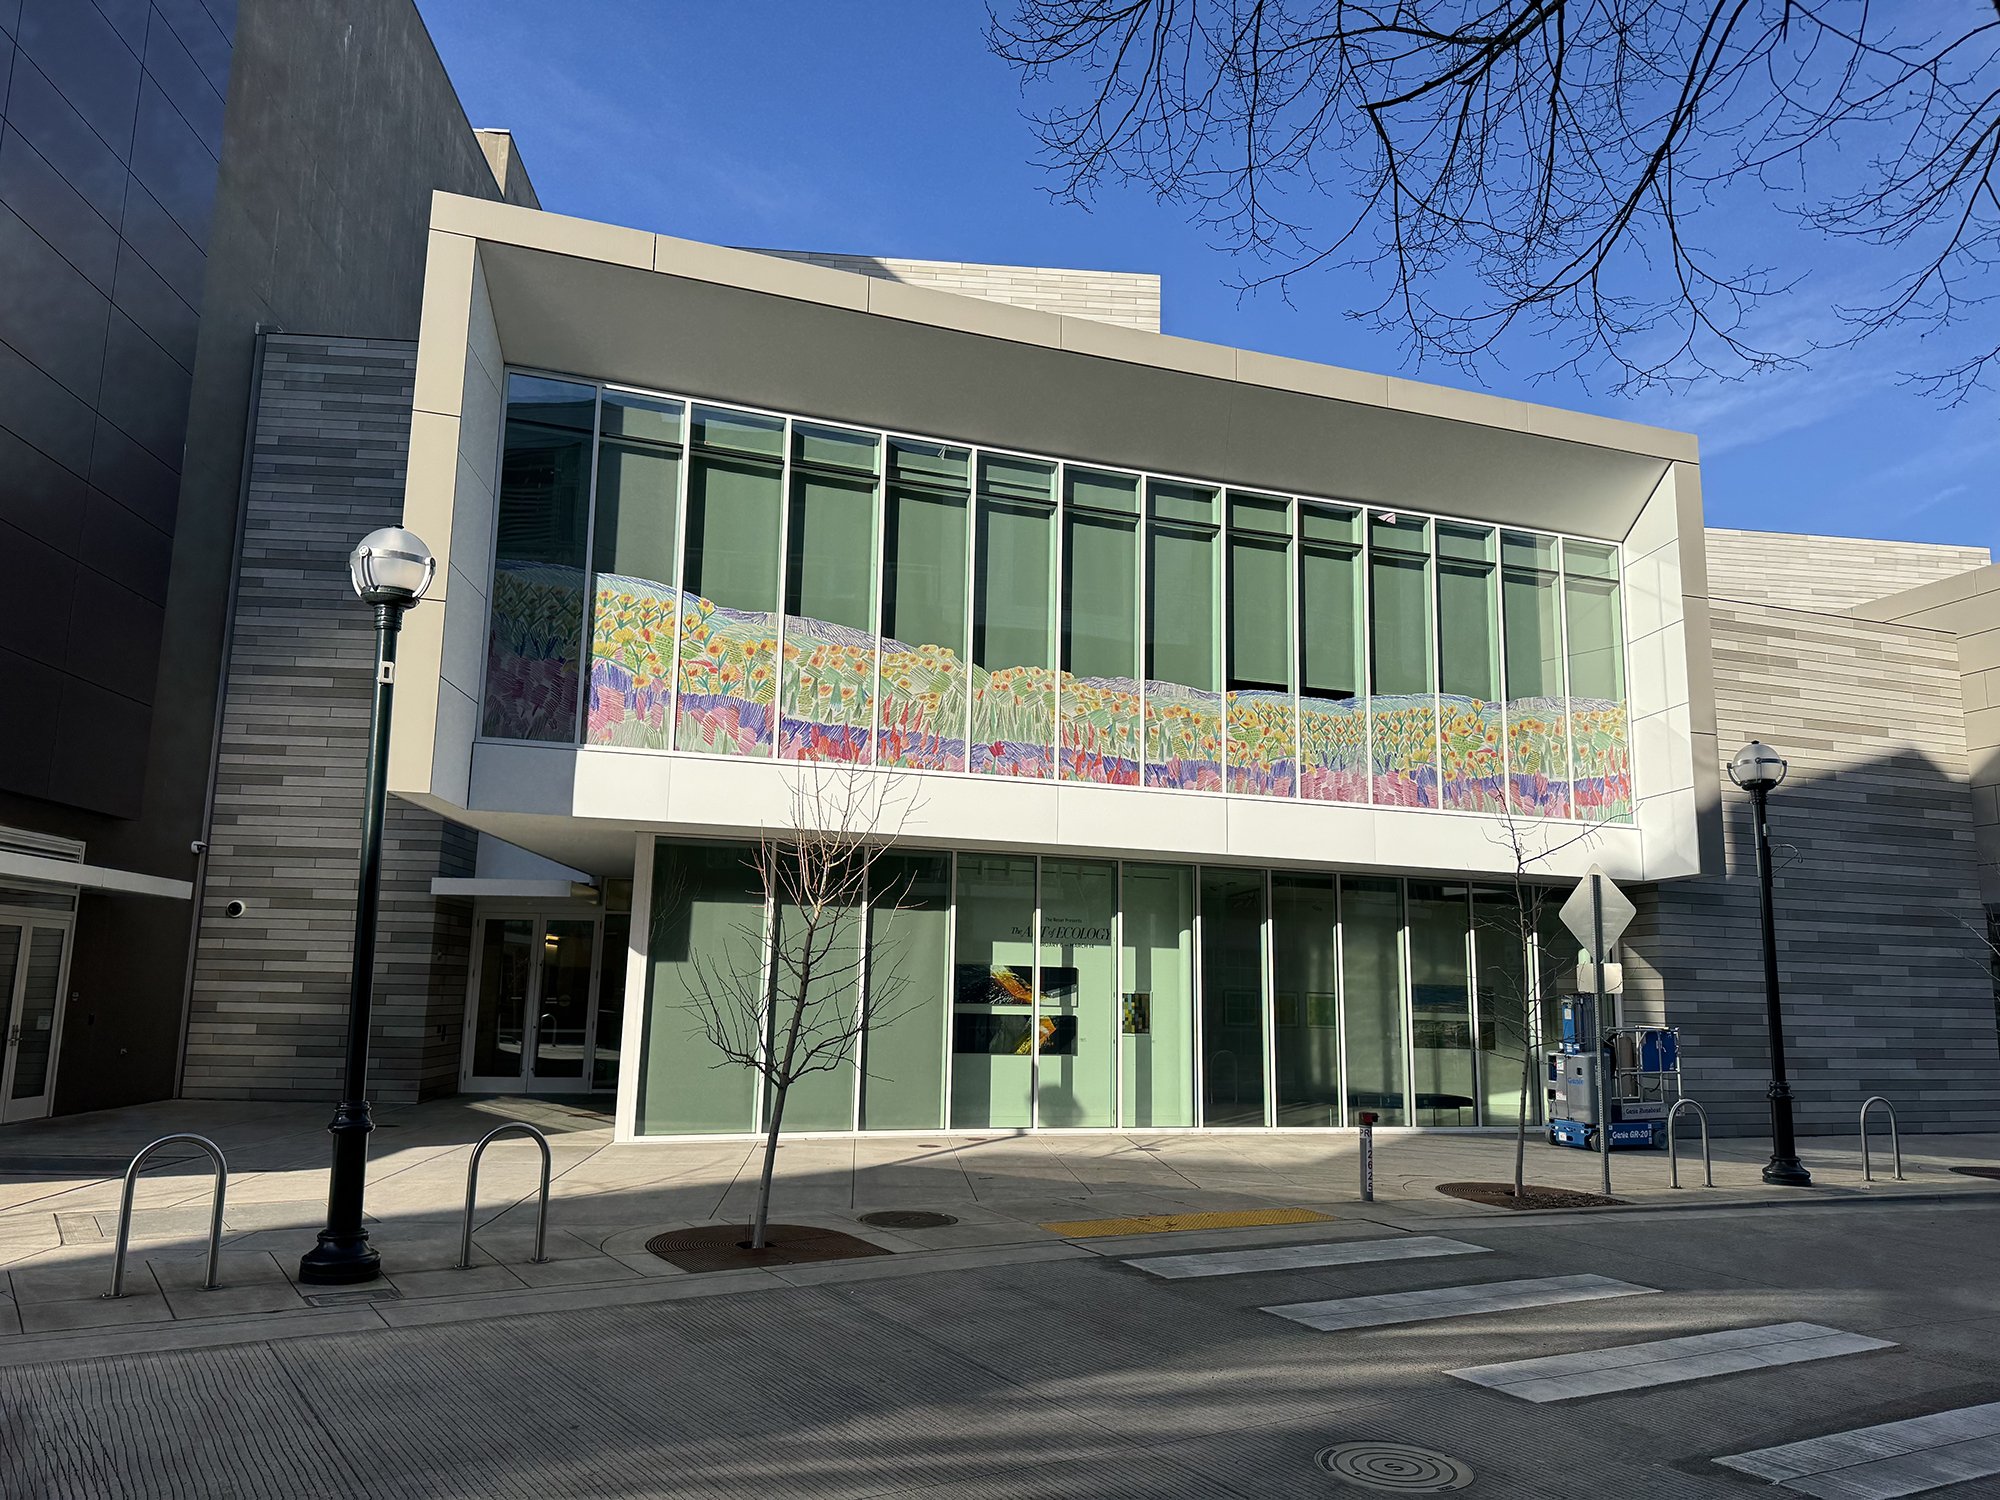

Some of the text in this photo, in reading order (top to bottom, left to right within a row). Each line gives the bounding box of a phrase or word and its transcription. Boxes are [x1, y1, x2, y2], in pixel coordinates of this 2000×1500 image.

[1011, 927, 1022, 935] The
[1020, 925, 1050, 938] AT
[1056, 926, 1111, 940] ECOLOGY
[1612, 1130, 1649, 1139] Genie GR-20
[1384, 1463, 1404, 1471] S
